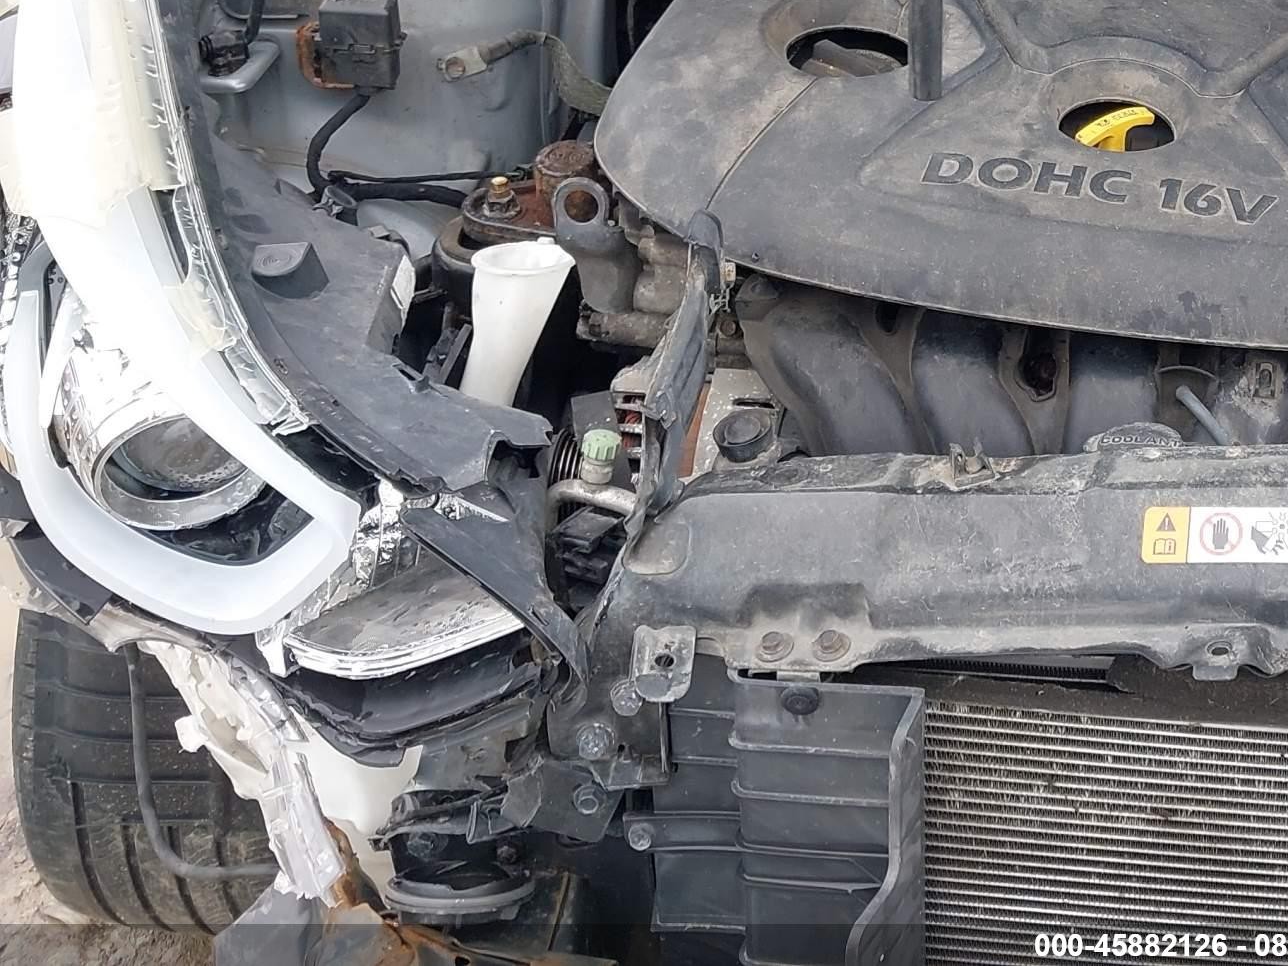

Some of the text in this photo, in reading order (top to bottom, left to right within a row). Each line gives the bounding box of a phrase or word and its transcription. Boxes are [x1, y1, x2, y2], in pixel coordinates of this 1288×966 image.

[921, 152, 1279, 225] DOHC 16V
[1100, 434, 1182, 448] COOLANT
